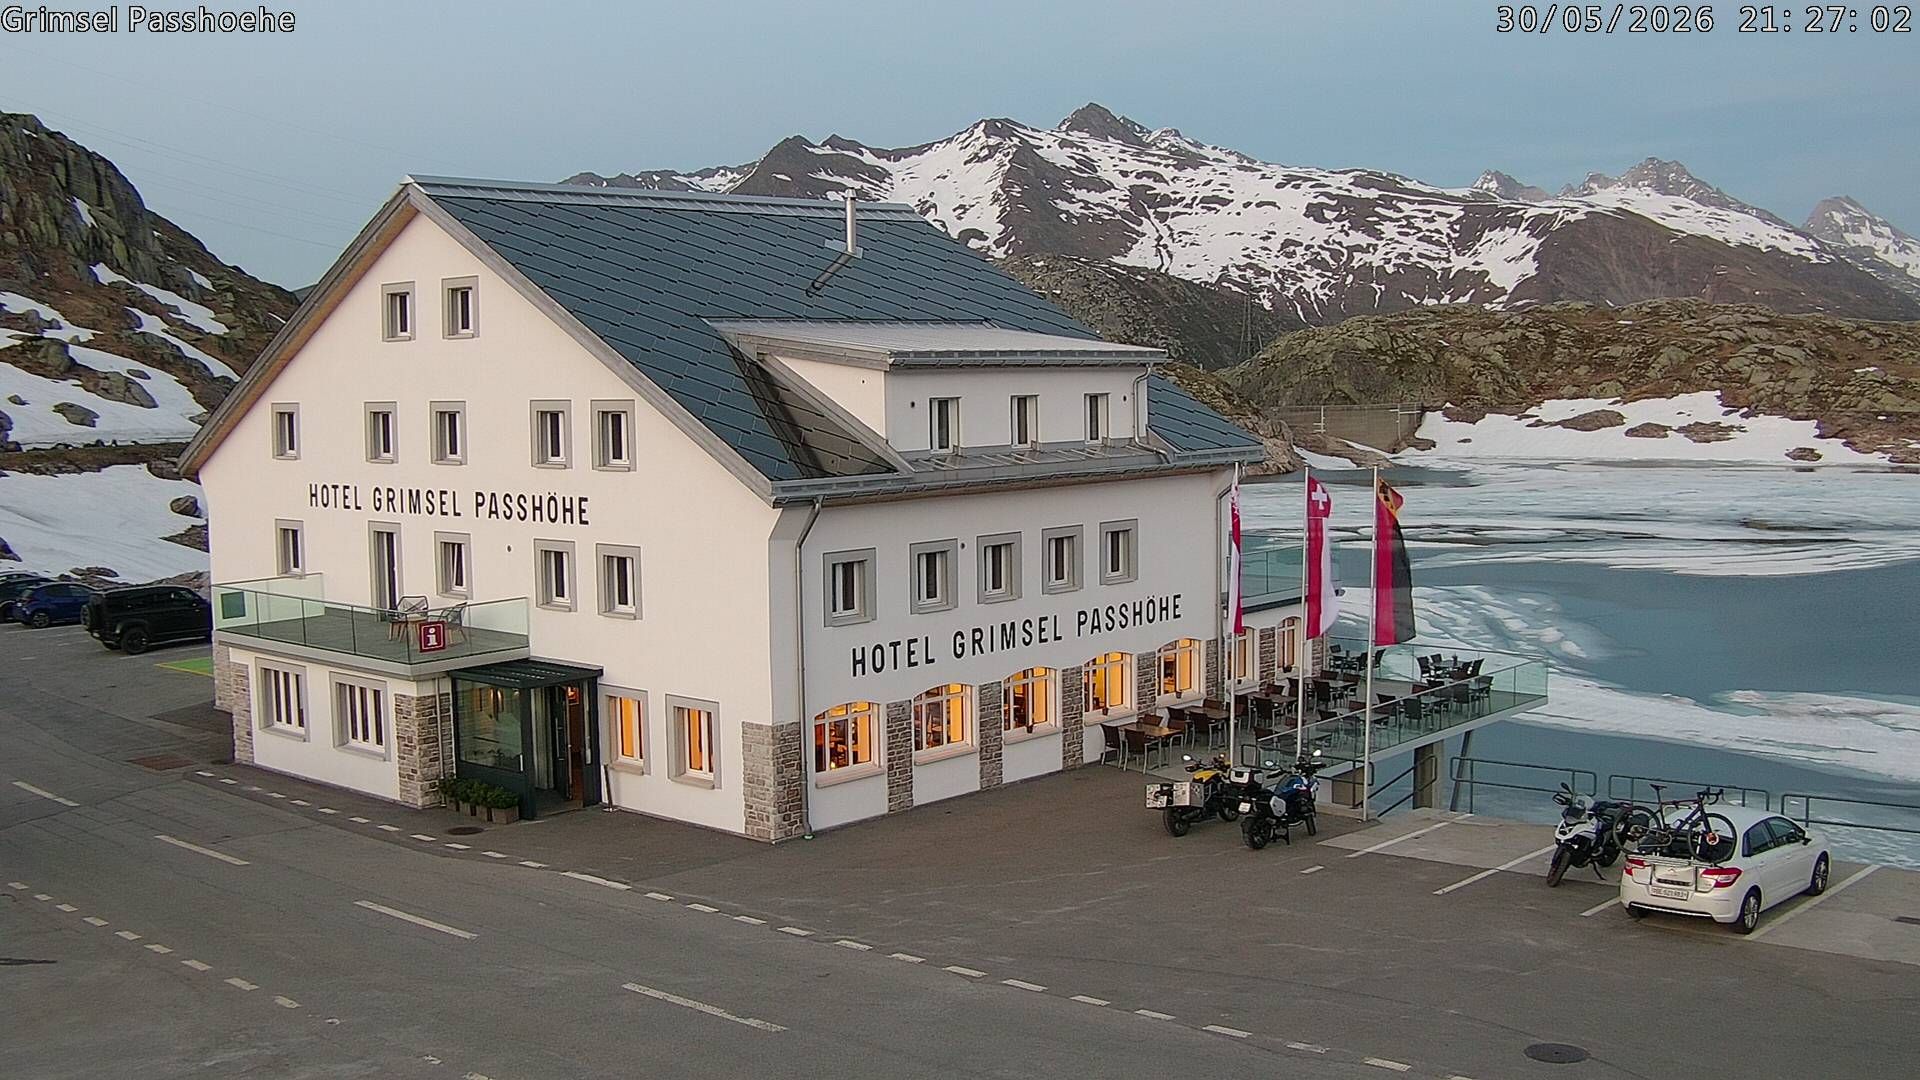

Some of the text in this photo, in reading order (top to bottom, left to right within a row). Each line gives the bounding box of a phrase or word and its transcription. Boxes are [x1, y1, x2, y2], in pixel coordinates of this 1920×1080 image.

[309, 483, 590, 525] HOTEL GRIMSEL PASSHÖHE
[426, 627, 438, 646] i
[852, 594, 1182, 677] HOTEL GRIMSEL PASSHÖHE
